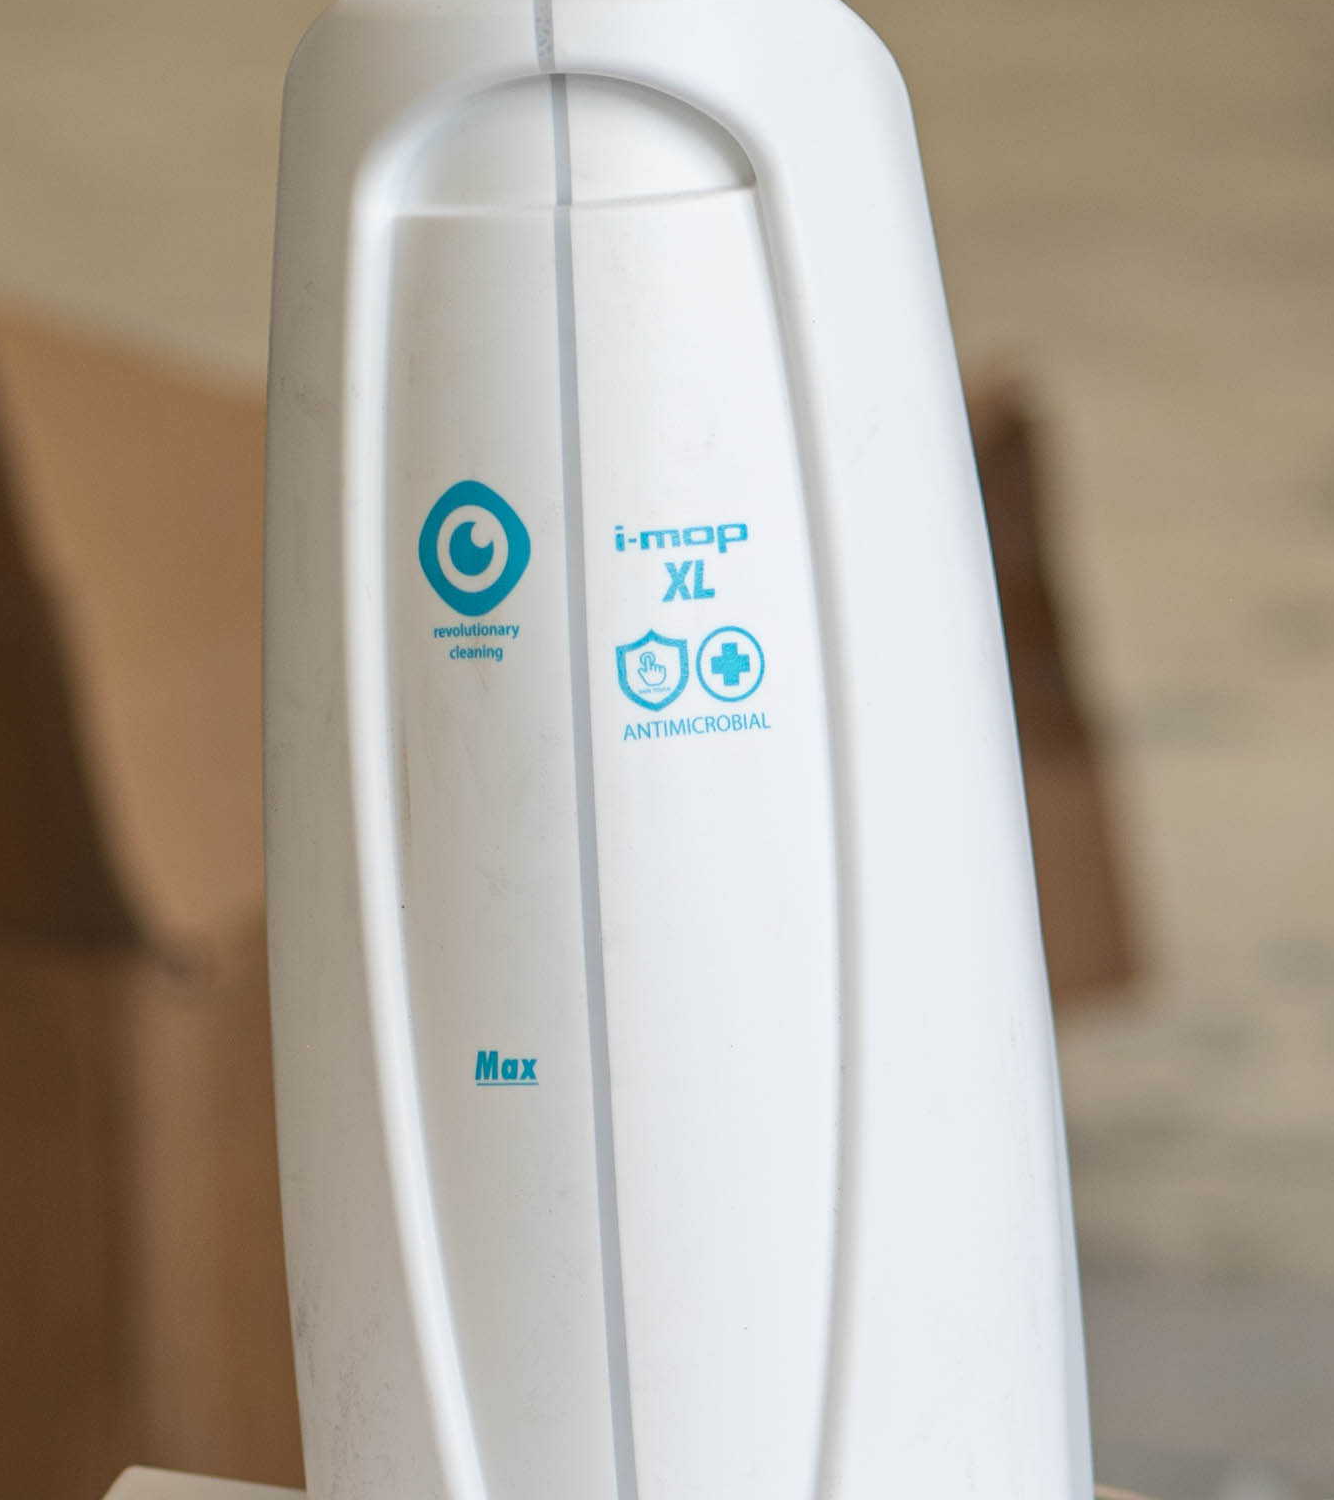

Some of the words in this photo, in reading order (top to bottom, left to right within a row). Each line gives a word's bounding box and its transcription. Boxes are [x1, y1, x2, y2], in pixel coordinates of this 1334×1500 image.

[614, 523, 748, 554] i-mop
[662, 559, 716, 602] XL
[434, 622, 521, 640] revolutionary
[449, 644, 504, 663] cleaning
[623, 711, 772, 741] ANTIMICROBIAL
[474, 1049, 538, 1081] Max
